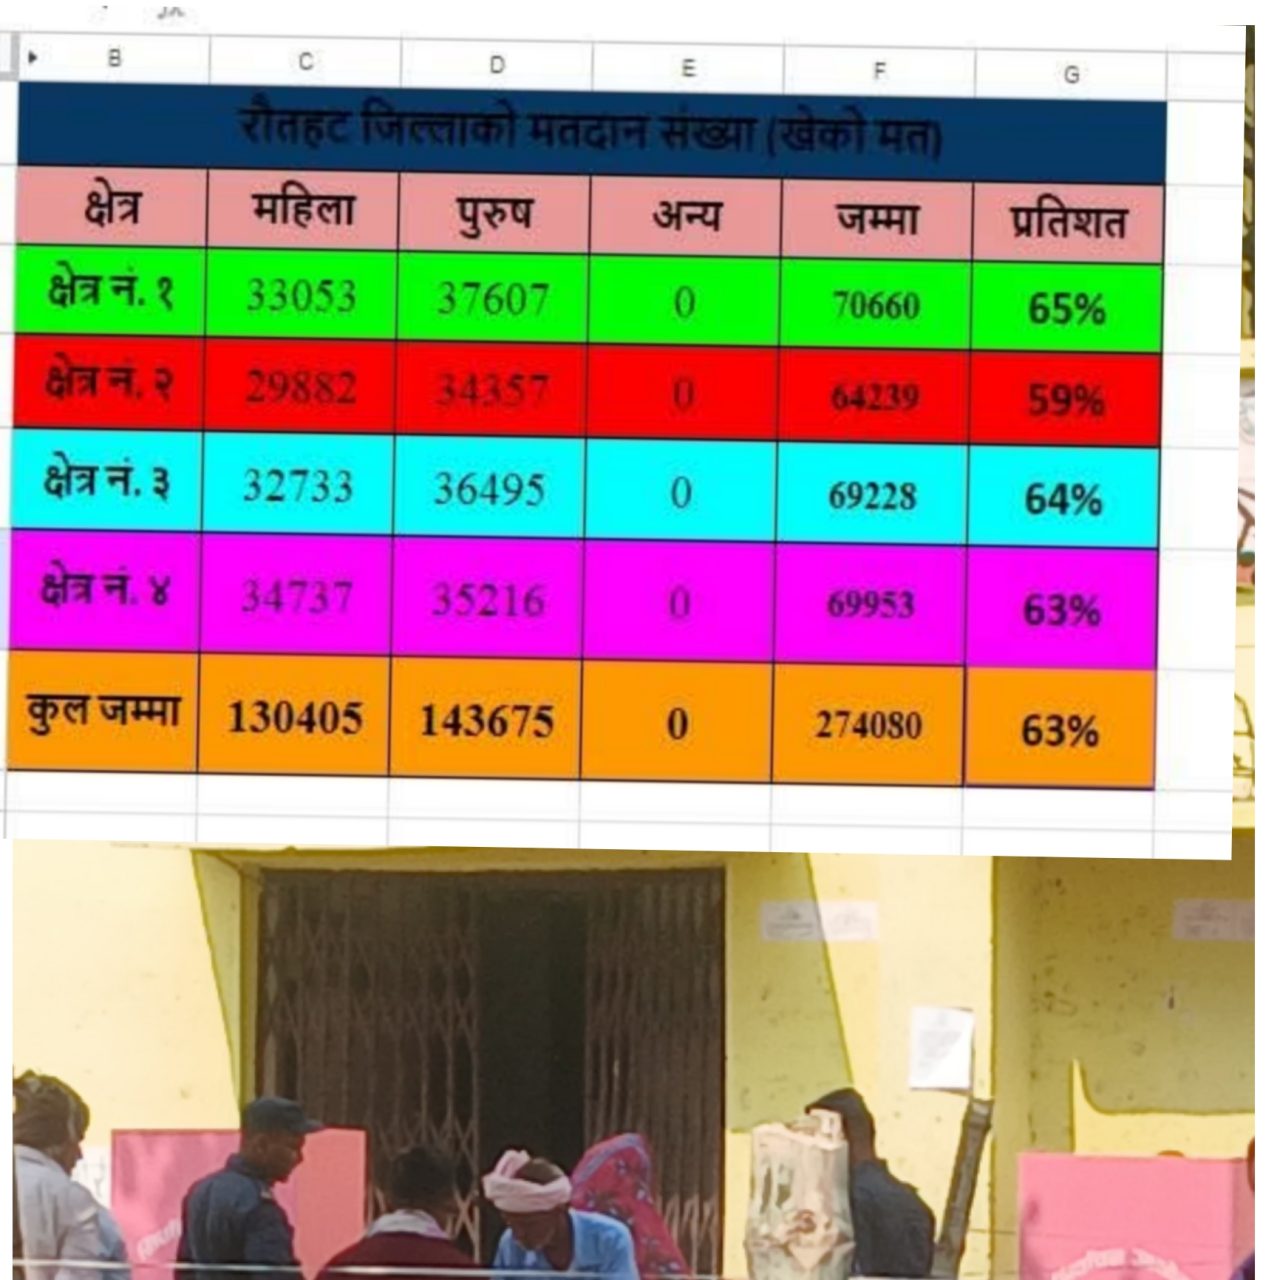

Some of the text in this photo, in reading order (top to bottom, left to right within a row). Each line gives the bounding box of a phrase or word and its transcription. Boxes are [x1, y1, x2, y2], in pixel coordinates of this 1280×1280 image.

[109, 49, 121, 67] B
[299, 52, 313, 70] C
[491, 55, 505, 74] D
[683, 59, 695, 77] E
[875, 62, 886, 78] F
[1064, 65, 1079, 84] G
[240, 94, 353, 147] रौतहट
[360, 97, 520, 146] जिल्लाको
[526, 114, 651, 150] मतदान
[873, 120, 942, 160] मत)
[85, 176, 143, 227] क्षेत्र
[251, 180, 357, 228] महिला
[653, 201, 724, 231] अन्य
[1009, 193, 1129, 238] प्रतिशत
[456, 197, 535, 239] पुरुष
[836, 204, 921, 235] जम्मा
[49, 261, 103, 308] क्षेत्र
[158, 277, 172, 310] १
[248, 278, 355, 311] 33053
[439, 282, 549, 315] 37607
[675, 286, 695, 318] 0
[834, 291, 920, 319] 70660
[1030, 292, 1105, 324] 65%
[46, 352, 100, 399] क्षेत्र
[155, 368, 173, 400] २
[247, 369, 355, 403] 29882
[440, 374, 549, 406] 34357
[674, 378, 694, 411] 0
[832, 384, 918, 410] 64239
[1030, 384, 1104, 416] 59%
[44, 451, 99, 498] क्षेत्र
[153, 467, 169, 500] ३
[244, 469, 352, 502] 32733
[435, 472, 544, 506] 36495
[671, 477, 691, 508] 0
[830, 482, 916, 509] 69228
[1026, 483, 1102, 515] 64%
[42, 560, 95, 606] क्षेत्र
[151, 577, 170, 605] ४
[242, 580, 352, 613] 34737
[434, 584, 544, 617] 35216
[670, 587, 690, 617] 0
[828, 592, 913, 617] 69953
[1024, 595, 1100, 625] 63%
[26, 694, 182, 736] कुल जम्मा
[230, 701, 362, 734] 130405
[423, 704, 553, 737] 143675
[668, 708, 688, 739] 0
[817, 710, 922, 739] 274080
[1022, 714, 1098, 747] 63%
